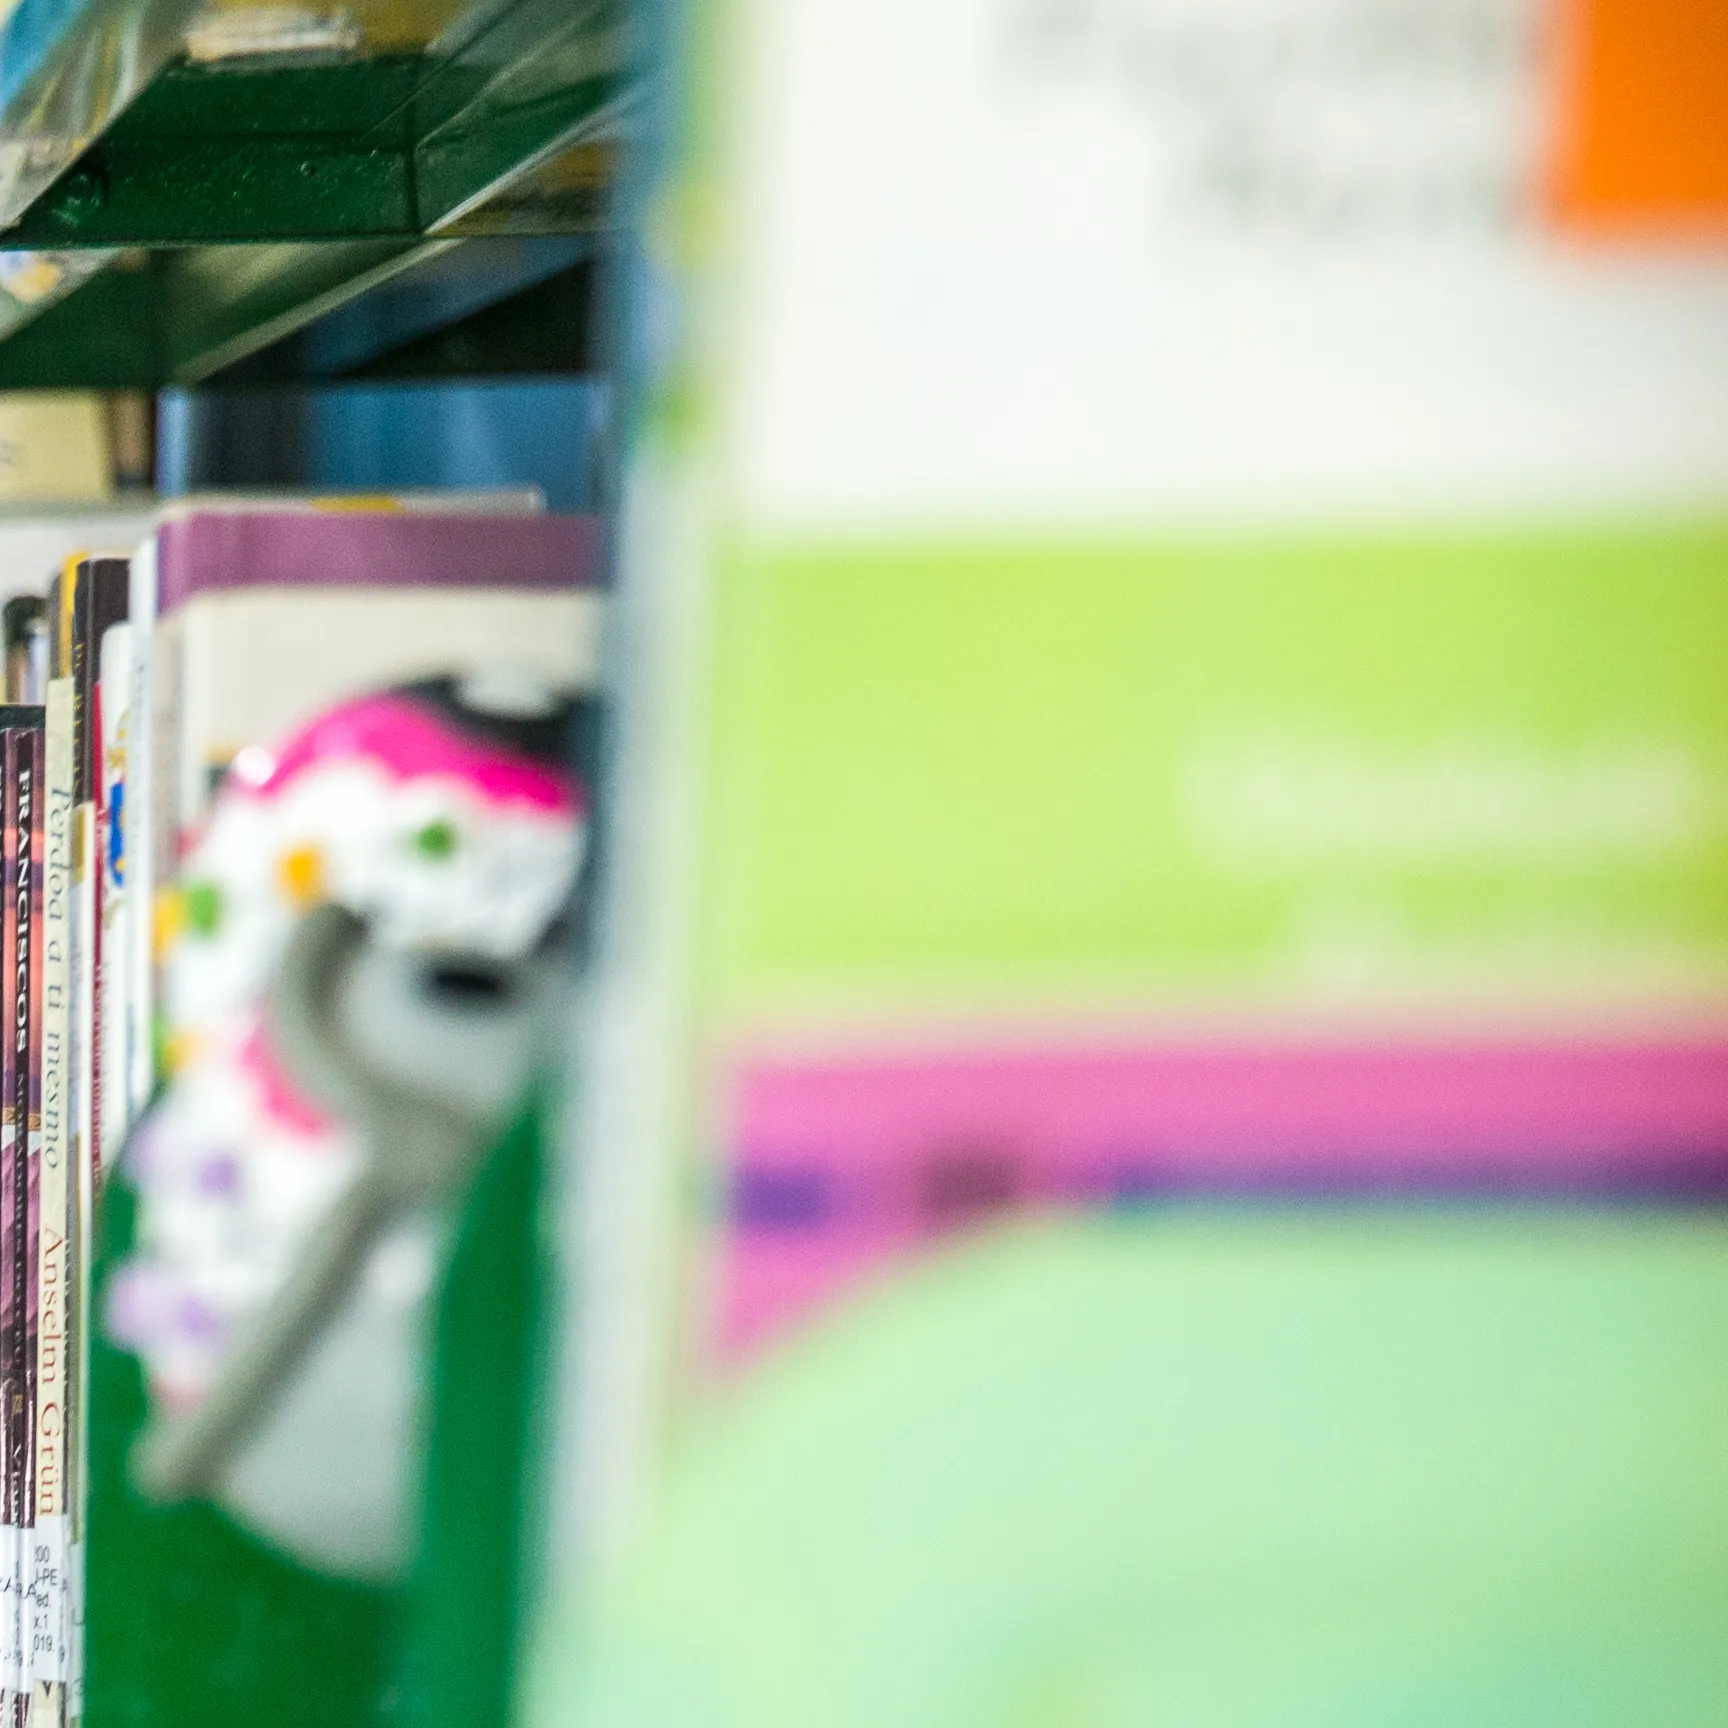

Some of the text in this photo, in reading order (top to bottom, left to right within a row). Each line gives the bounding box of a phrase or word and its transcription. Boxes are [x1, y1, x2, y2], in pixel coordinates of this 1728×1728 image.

[16, 767, 31, 1053] FRANCISCOS
[39, 787, 73, 1517] Perdoa a ti mesmo Anselm Grün
